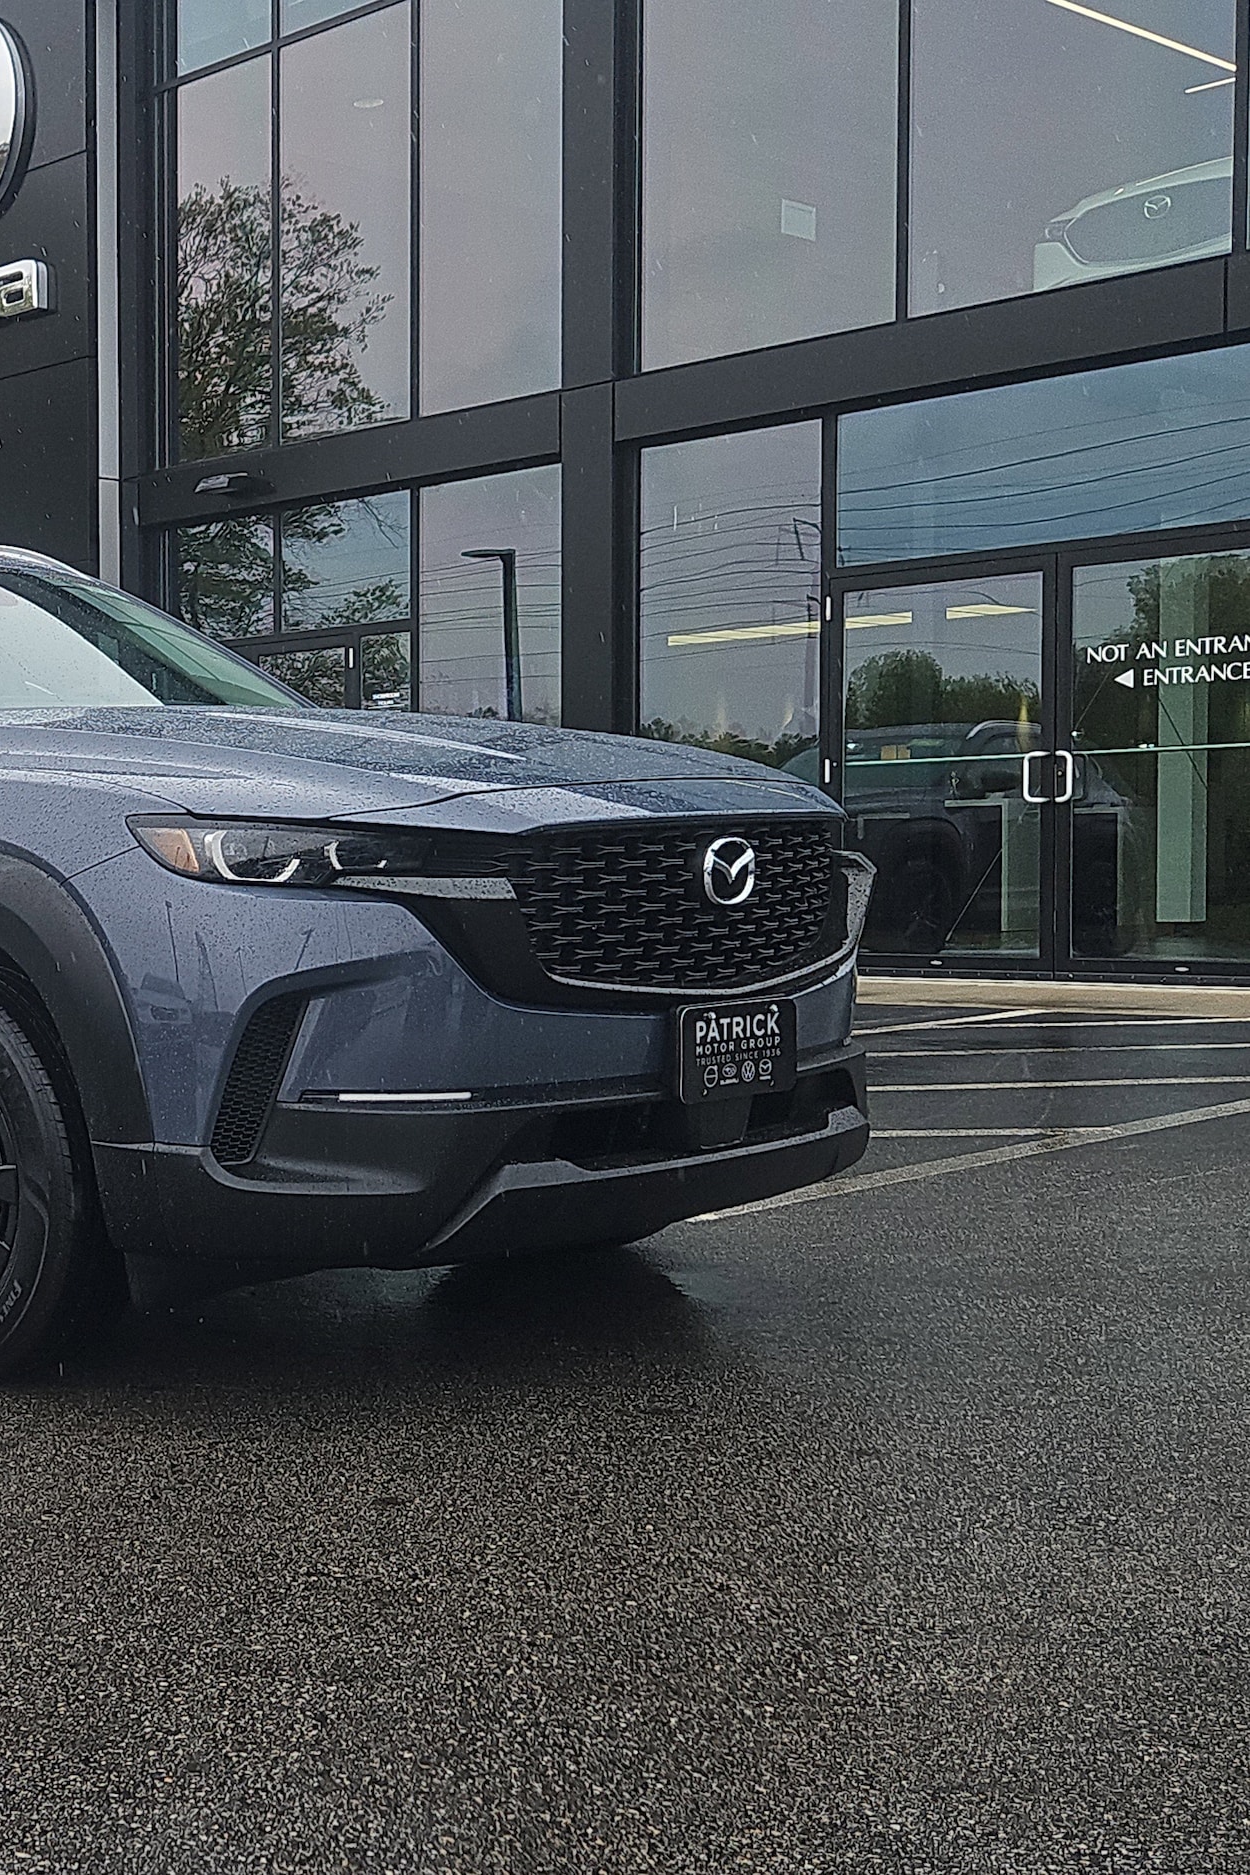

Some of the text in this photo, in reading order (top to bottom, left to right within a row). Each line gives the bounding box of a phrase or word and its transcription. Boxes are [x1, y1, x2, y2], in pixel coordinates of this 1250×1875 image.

[1086, 643, 1129, 664] NOT
[1135, 640, 1168, 660] AN
[1143, 661, 1250, 686] ENTRANCE
[695, 1012, 780, 1044] PATRICK
[695, 1036, 781, 1056] MOTOR GROUP
[695, 1047, 781, 1067] TRUSTED SINCE 1936
